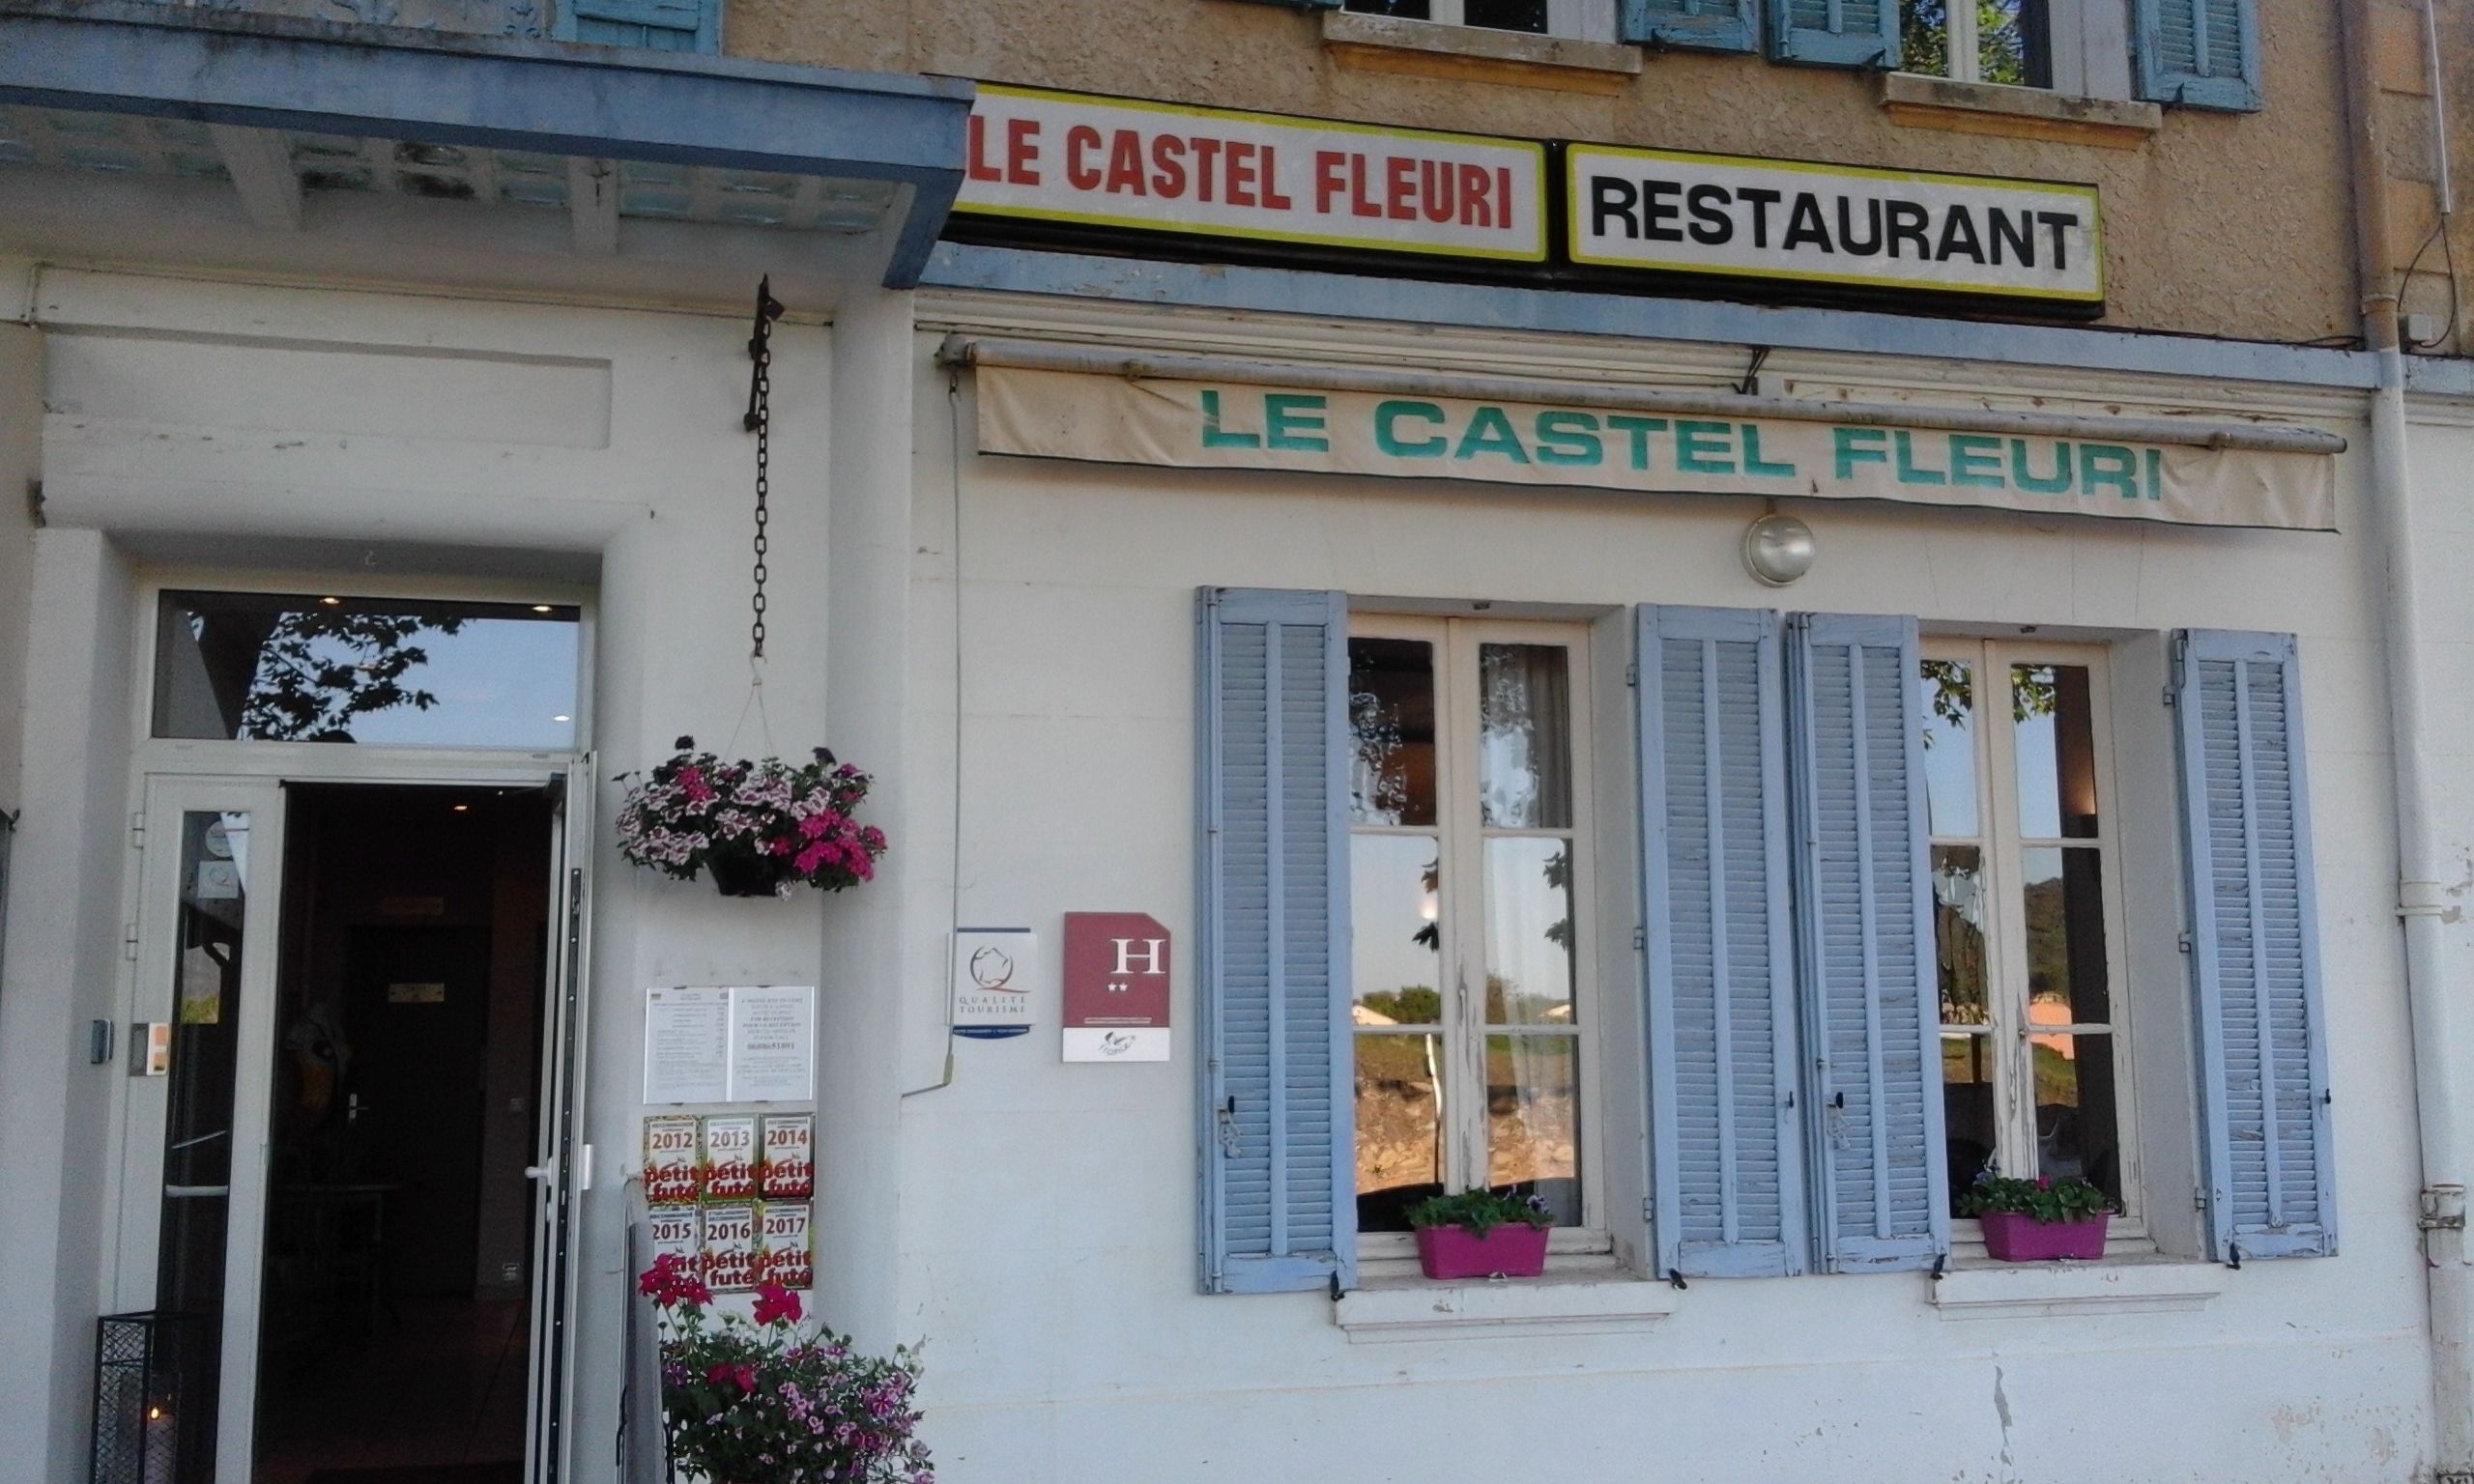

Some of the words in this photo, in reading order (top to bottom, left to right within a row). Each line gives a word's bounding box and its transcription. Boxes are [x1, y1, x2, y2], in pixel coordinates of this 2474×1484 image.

[968, 114, 1040, 186] LE
[1065, 124, 1292, 212] CASTEL
[1315, 150, 1512, 230] FLEURI
[1589, 174, 2080, 271] RESTAURANT
[1200, 389, 1330, 453] LE
[1373, 399, 1796, 478] CASTEL
[1832, 426, 2161, 501] FLEURI
[1109, 937, 1167, 975] H
[959, 1005, 1026, 1013] TOURISME
[651, 1132, 693, 1150] 2012
[709, 1130, 751, 1148] 2013
[766, 1128, 808, 1146] 2014
[652, 1222, 691, 1241] 2015
[707, 1222, 751, 1241] 2016
[765, 1217, 806, 1235] 2017
